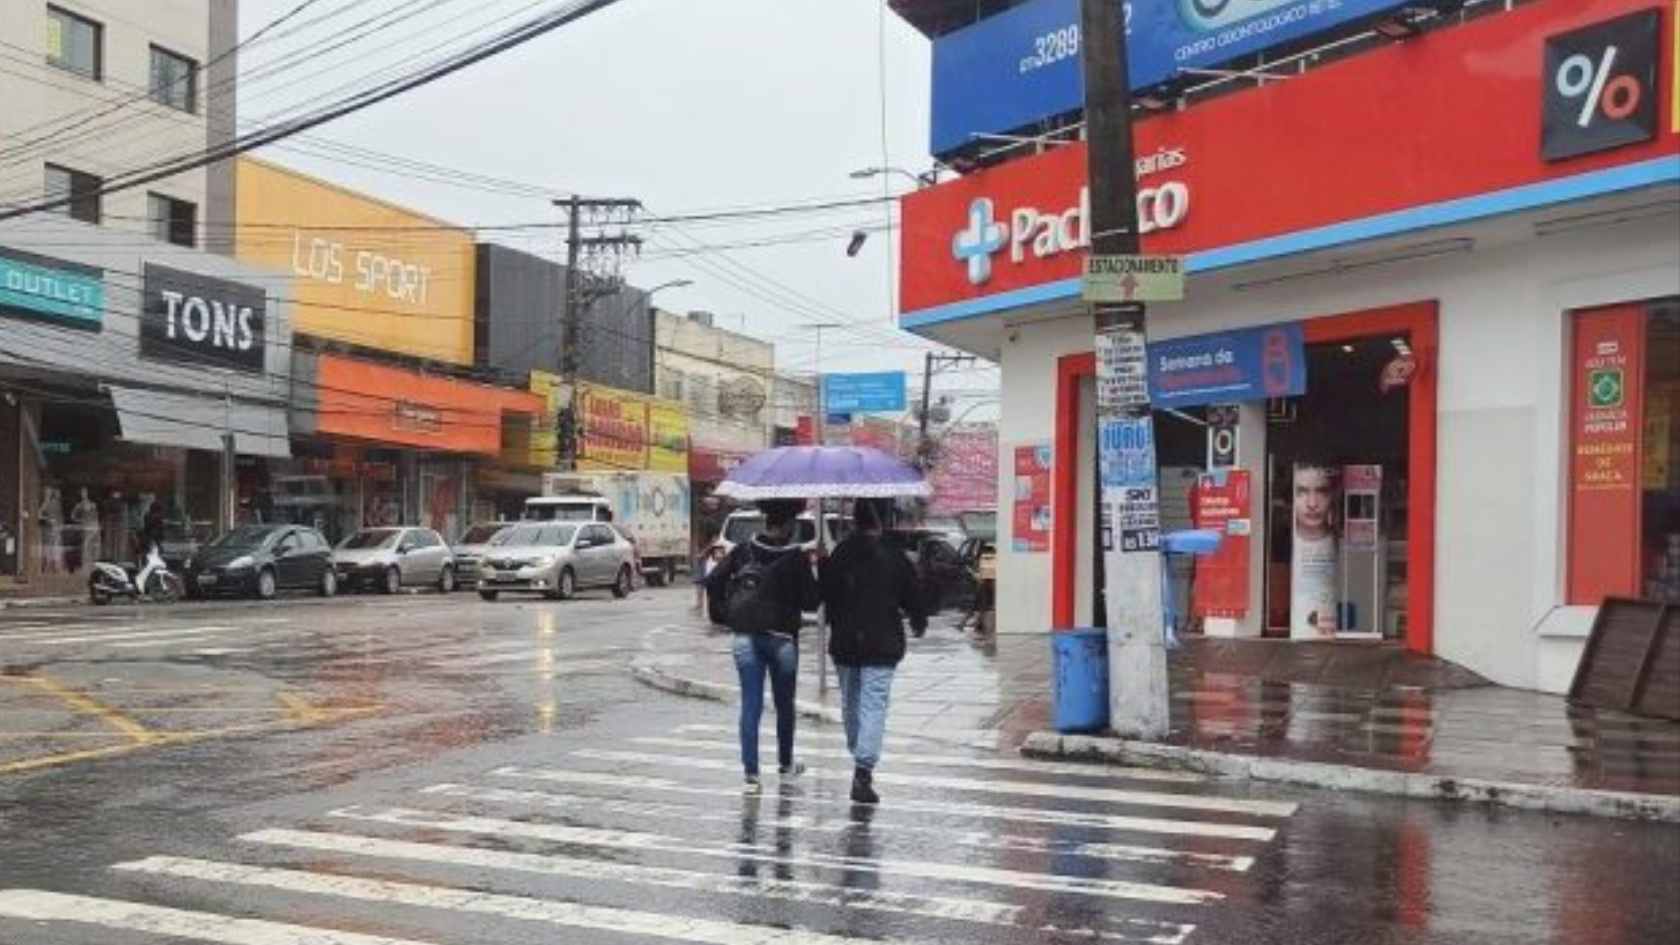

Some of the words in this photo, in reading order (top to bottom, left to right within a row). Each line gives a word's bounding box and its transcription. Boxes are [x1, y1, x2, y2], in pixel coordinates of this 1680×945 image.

[1011, 181, 1190, 263] Pacco
[8, 269, 94, 303] OUTLET
[293, 230, 343, 284] LOS
[355, 251, 430, 304] SPORT
[1089, 258, 1178, 273] ESTACIONAMENTO
[162, 291, 253, 350] TONS
